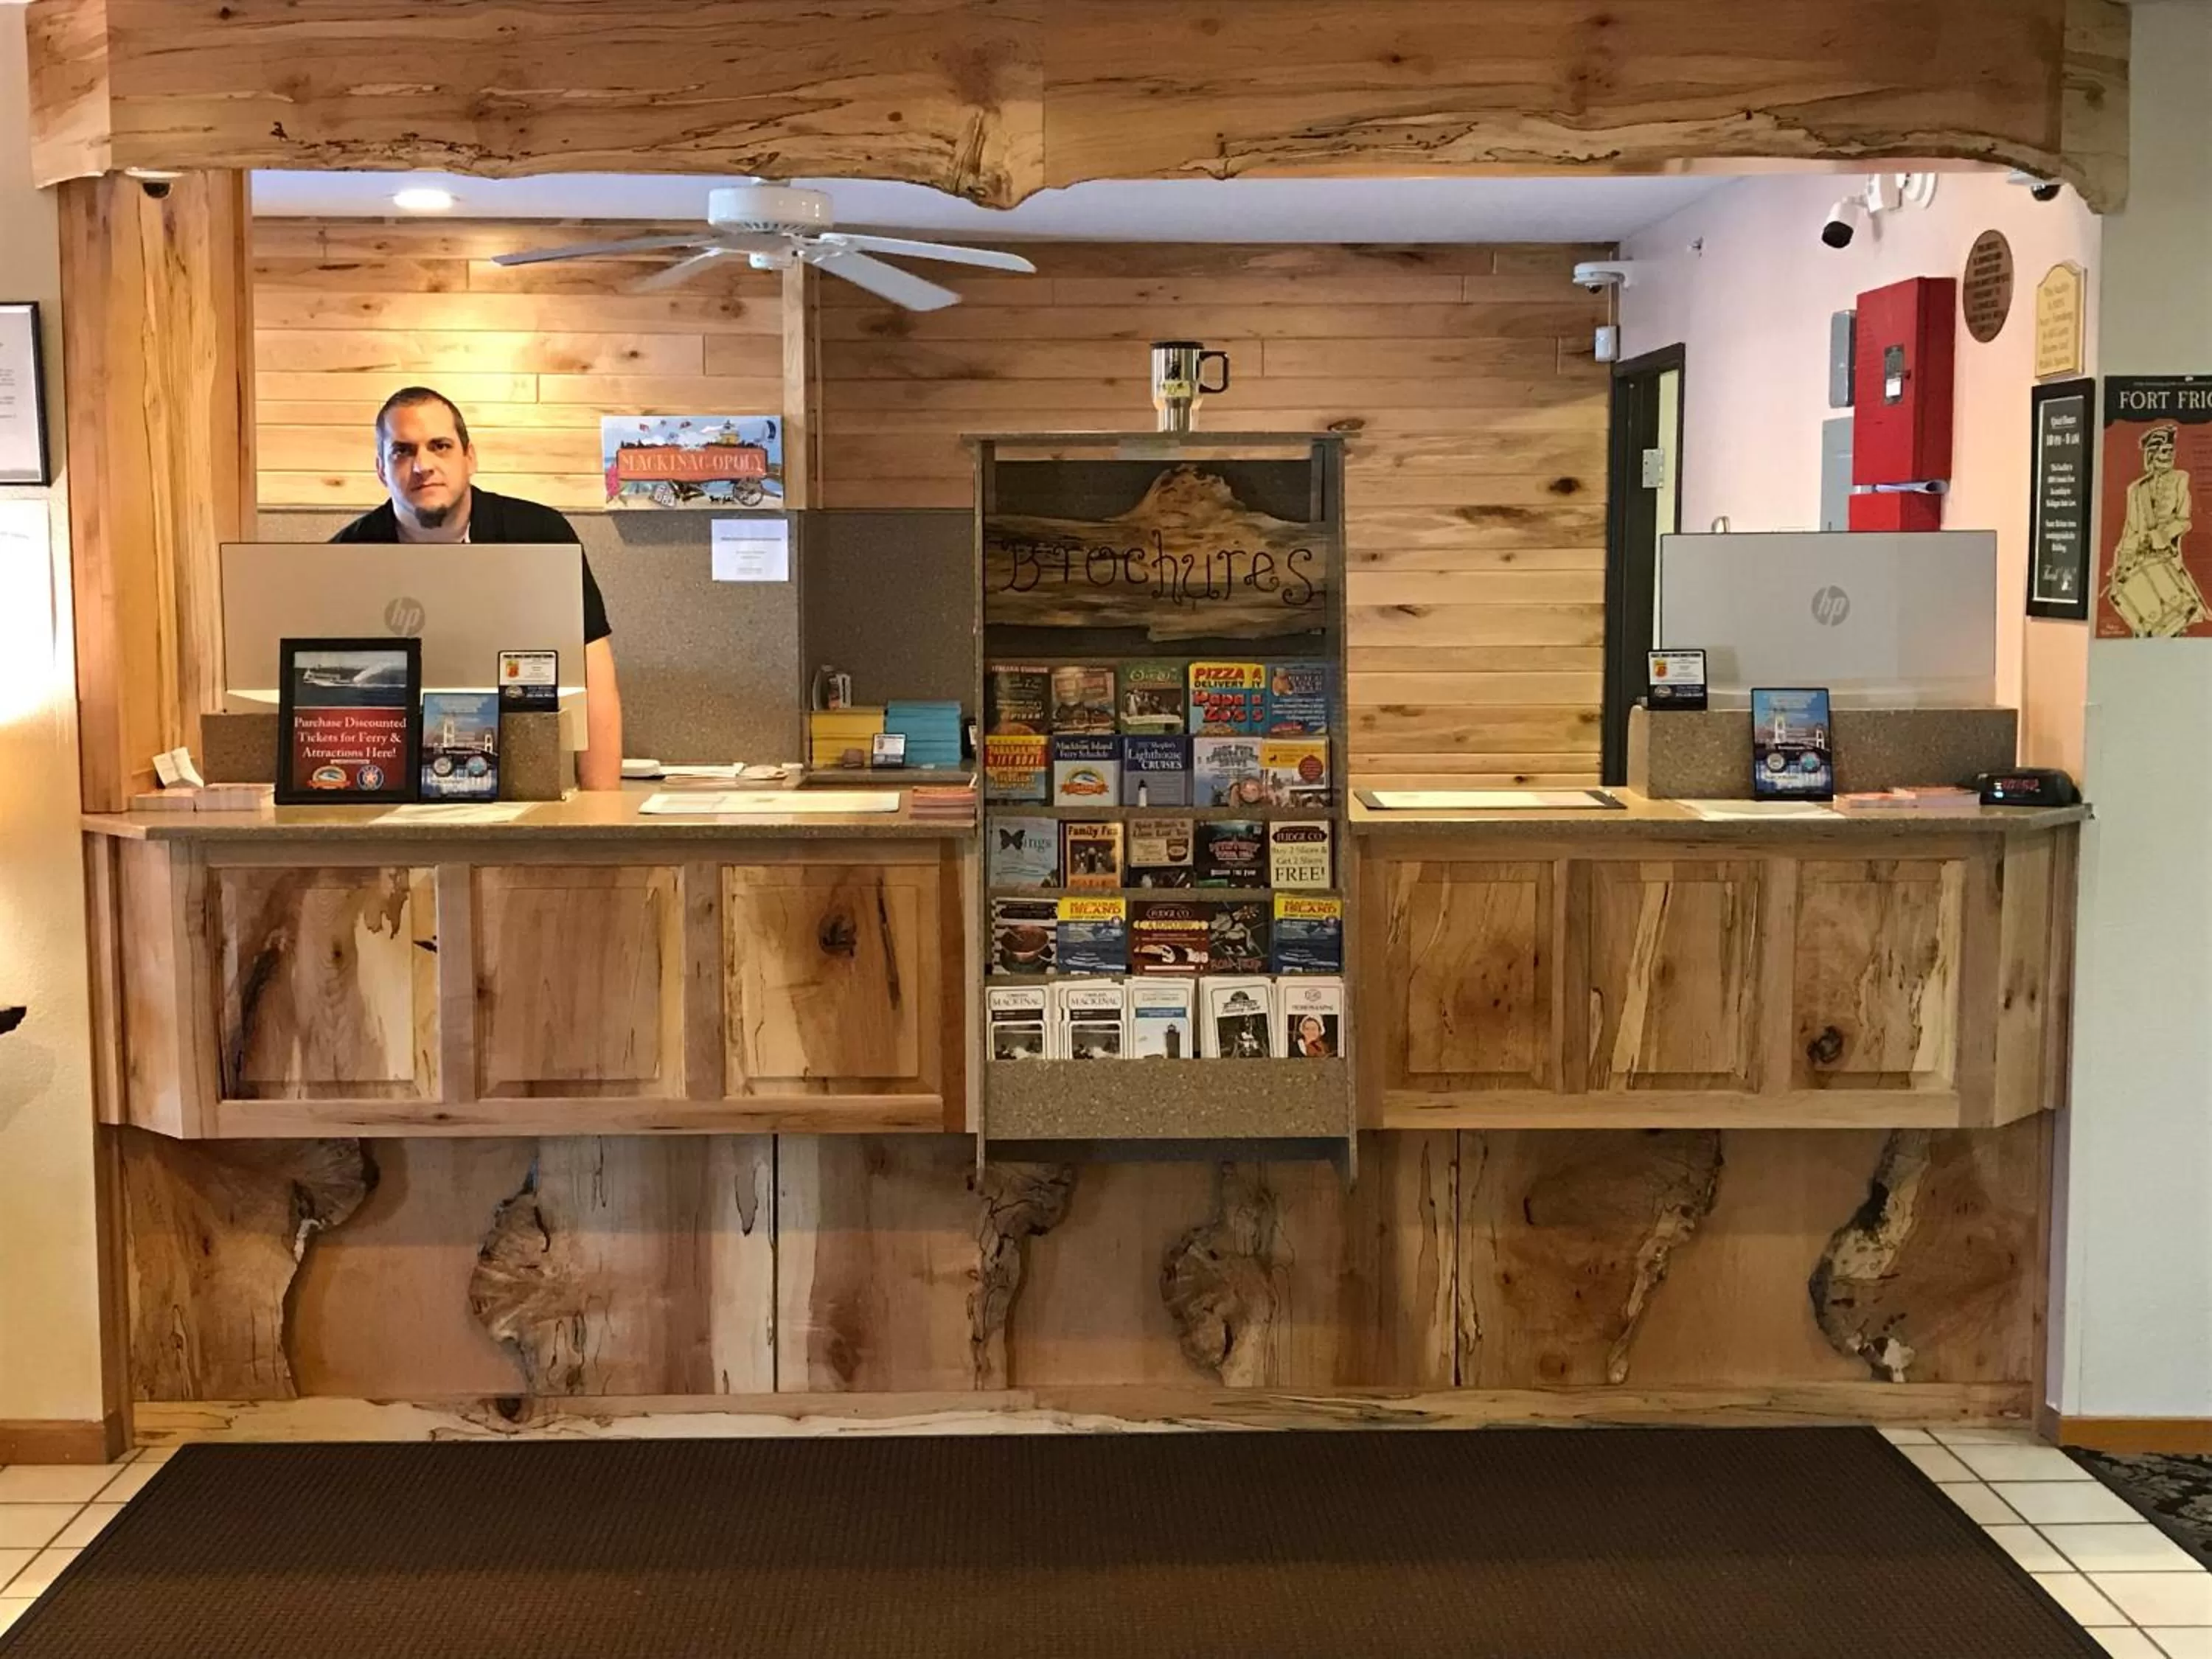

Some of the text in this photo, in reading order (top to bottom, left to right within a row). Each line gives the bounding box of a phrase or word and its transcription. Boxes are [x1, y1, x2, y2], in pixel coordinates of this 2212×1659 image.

[2119, 391, 2171, 409] FORT
[1001, 529, 1326, 606] Brochures
[1818, 588, 1847, 626] hp
[391, 598, 420, 636] hp
[1194, 667, 1245, 679] PIZZA
[1192, 690, 1245, 706] Papa
[294, 715, 407, 728] Purchase Discounted
[298, 731, 401, 745] Tickets for Ferry &
[302, 746, 397, 759] Attractions Here!
[1128, 748, 1181, 763] Lighthouse
[1141, 760, 1183, 771] CRUISES
[1068, 825, 1098, 838] Family
[1275, 866, 1326, 883] FREE!
[1071, 905, 1121, 914] ISLAND
[1284, 904, 1338, 913] ISLAND
